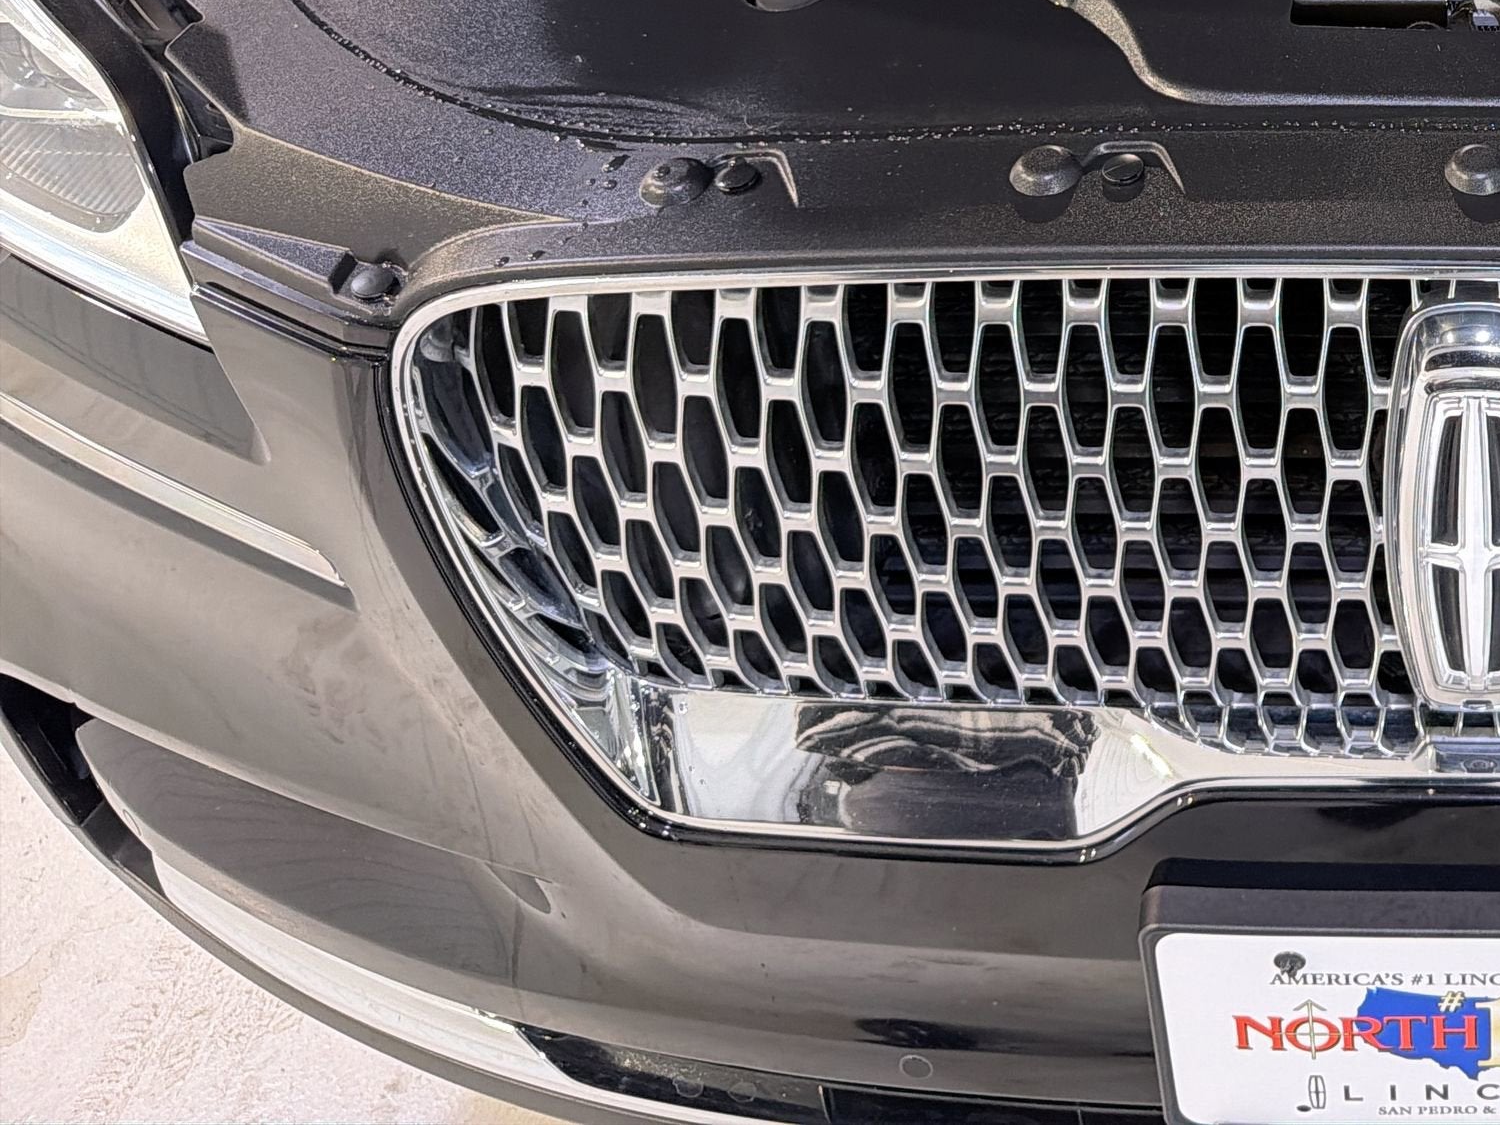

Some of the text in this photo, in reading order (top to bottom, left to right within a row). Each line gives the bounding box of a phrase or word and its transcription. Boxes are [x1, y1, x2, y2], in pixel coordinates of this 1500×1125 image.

[1270, 973, 1403, 986] AMERICA'S
[1411, 973, 1433, 986] #1
[1232, 1015, 1479, 1051] NORTH
[1379, 1106, 1413, 1116] SAN
[1418, 1105, 1477, 1115] PEDRO
[1483, 1105, 1498, 1115] &
